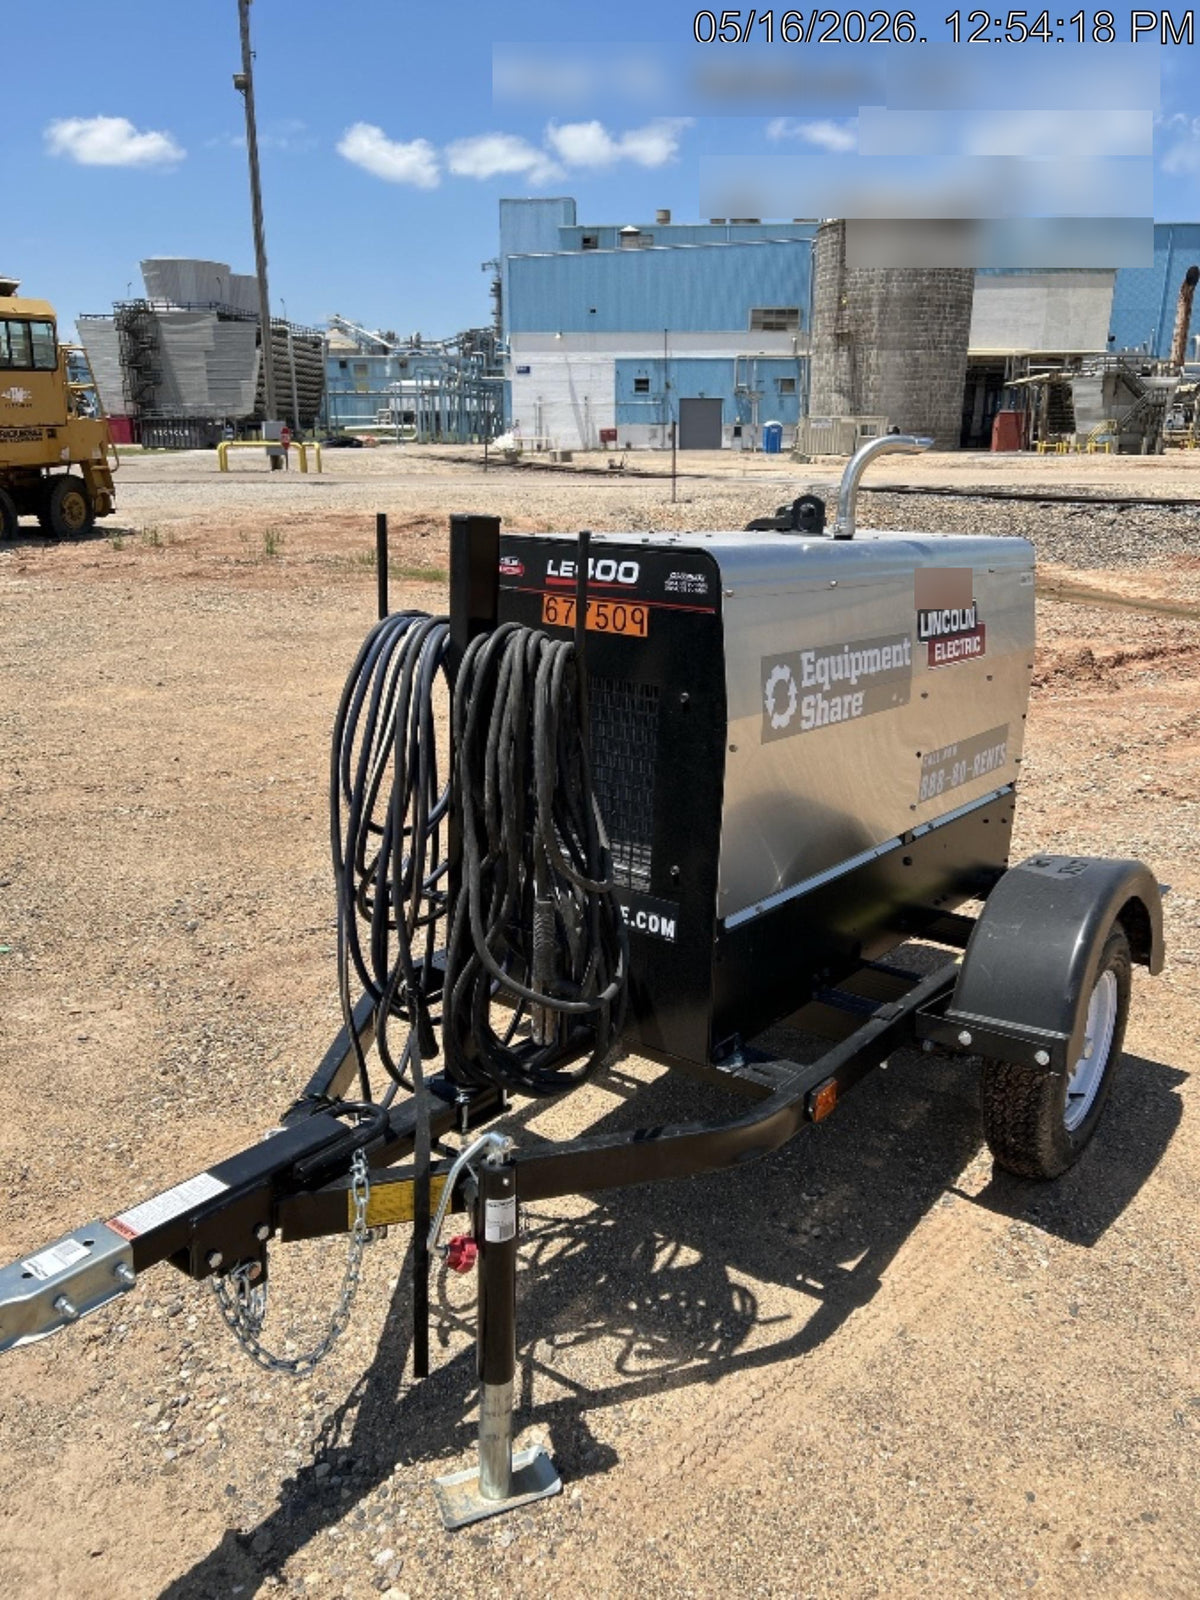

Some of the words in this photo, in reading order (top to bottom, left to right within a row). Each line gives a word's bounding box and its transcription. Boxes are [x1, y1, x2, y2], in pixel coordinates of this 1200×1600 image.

[920, 607, 975, 637] LINCOLN
[801, 638, 911, 690] Equipment
[935, 636, 981, 662] ELECTRIC
[801, 690, 866, 730] Share
